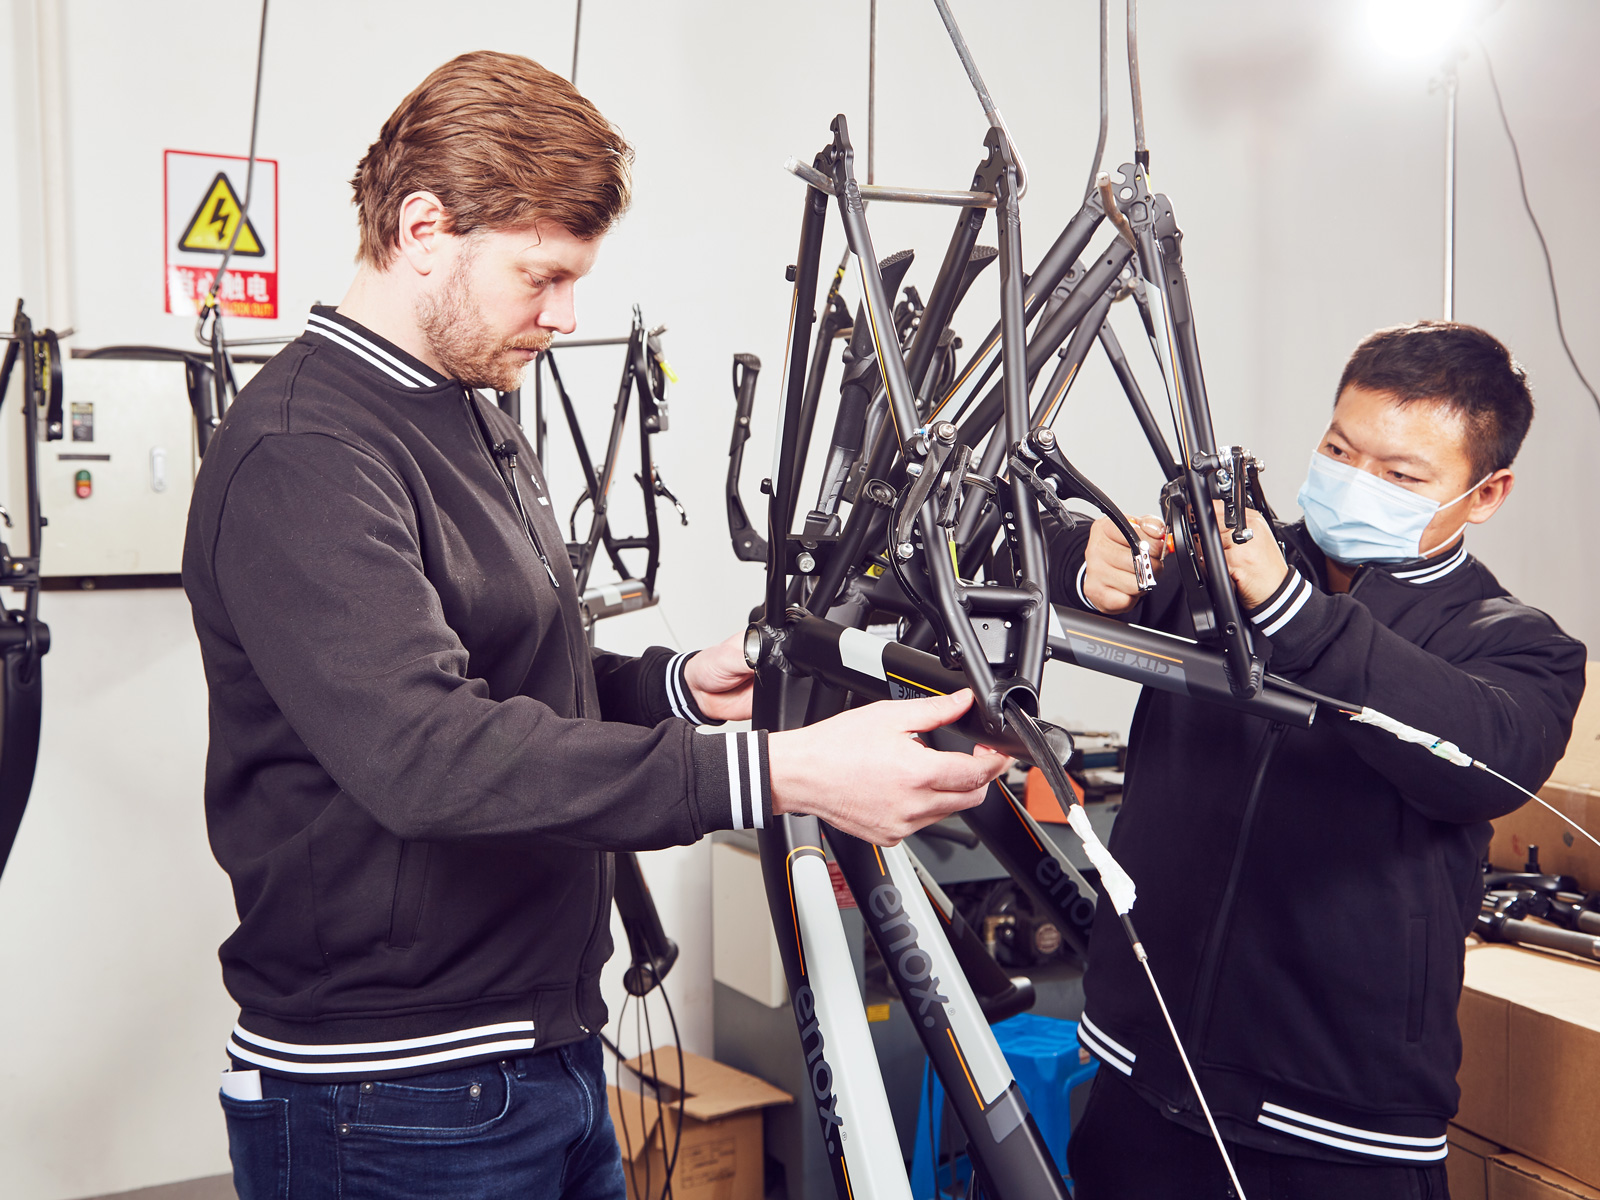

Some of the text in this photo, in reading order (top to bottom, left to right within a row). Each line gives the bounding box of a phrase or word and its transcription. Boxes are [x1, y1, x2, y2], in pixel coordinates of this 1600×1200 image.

[1085, 642, 1170, 675] CITY BIKE
[1036, 856, 1096, 936] eno
